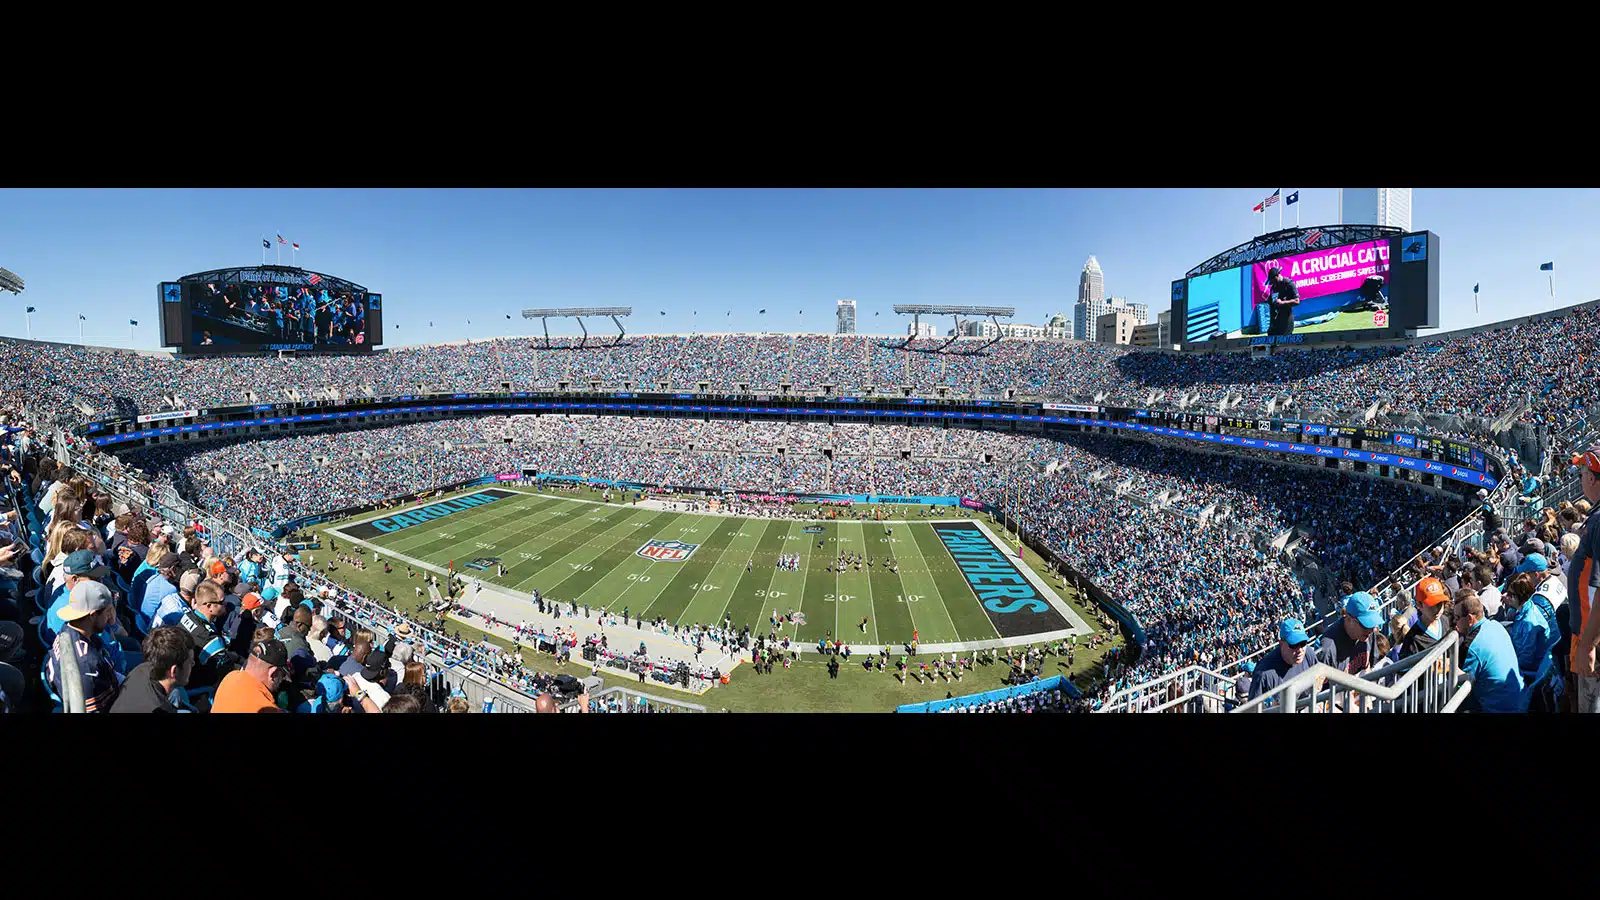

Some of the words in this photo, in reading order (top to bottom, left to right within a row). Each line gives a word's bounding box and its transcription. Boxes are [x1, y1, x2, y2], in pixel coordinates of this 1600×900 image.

[1291, 261, 1301, 277] A
[1302, 251, 1357, 274] CRUCIAL
[1295, 276, 1320, 288] NNUAL
[1320, 269, 1357, 284] SCREENING
[1357, 265, 1376, 277] SAVES
[372, 493, 501, 533] CAROLINA
[642, 546, 685, 560] NFL
[936, 528, 1049, 613] PANTHERS
[627, 573, 651, 583] 50
[689, 583, 713, 592] 40
[755, 589, 782, 599] 30
[824, 594, 852, 602] 20
